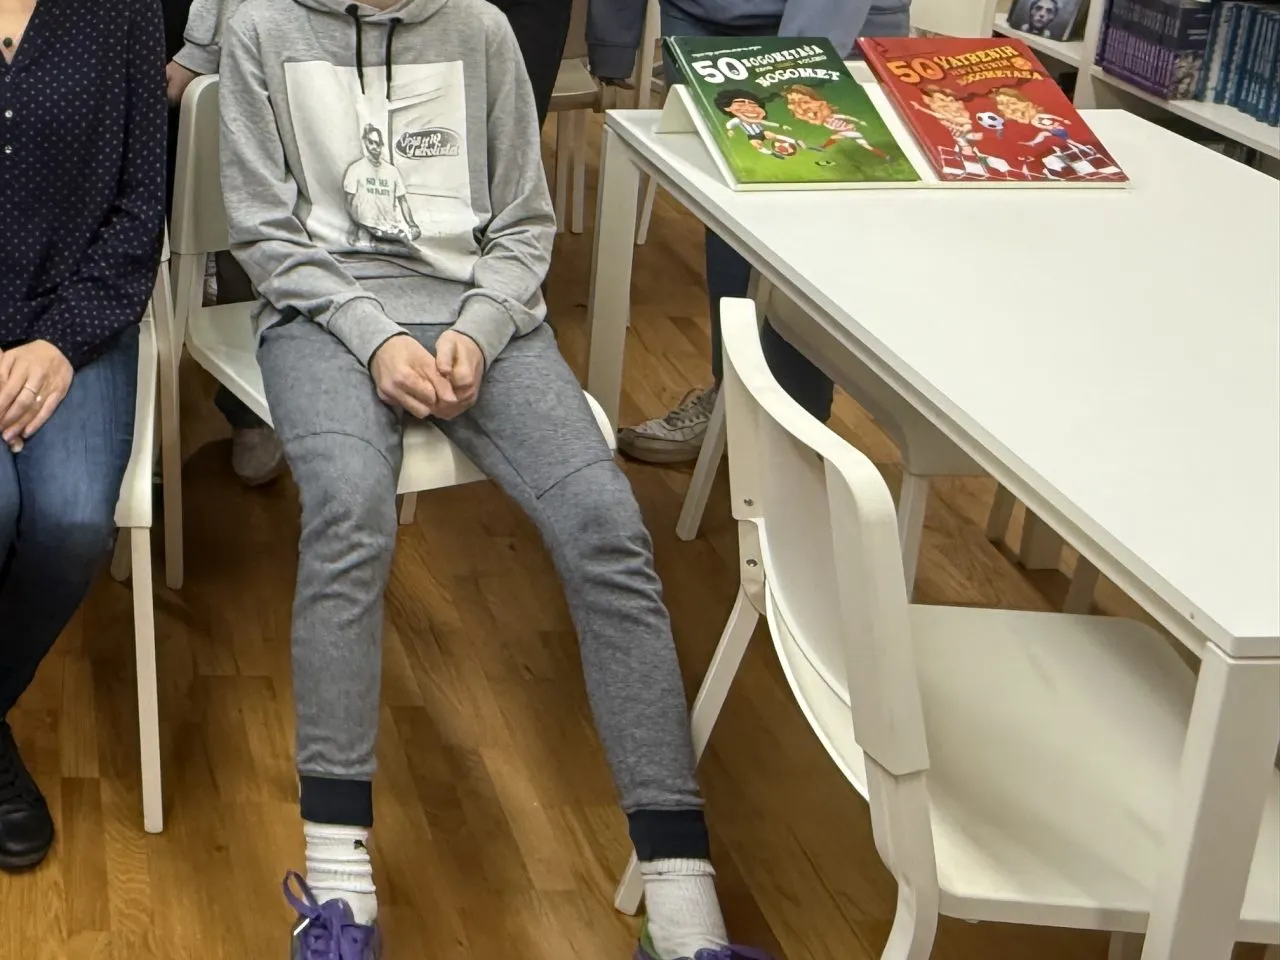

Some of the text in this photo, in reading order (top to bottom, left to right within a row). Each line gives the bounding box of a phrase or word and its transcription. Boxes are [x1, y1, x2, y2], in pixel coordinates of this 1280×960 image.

[691, 57, 749, 84] 50
[755, 67, 841, 88] NOGOMET
[886, 58, 946, 84] 50
